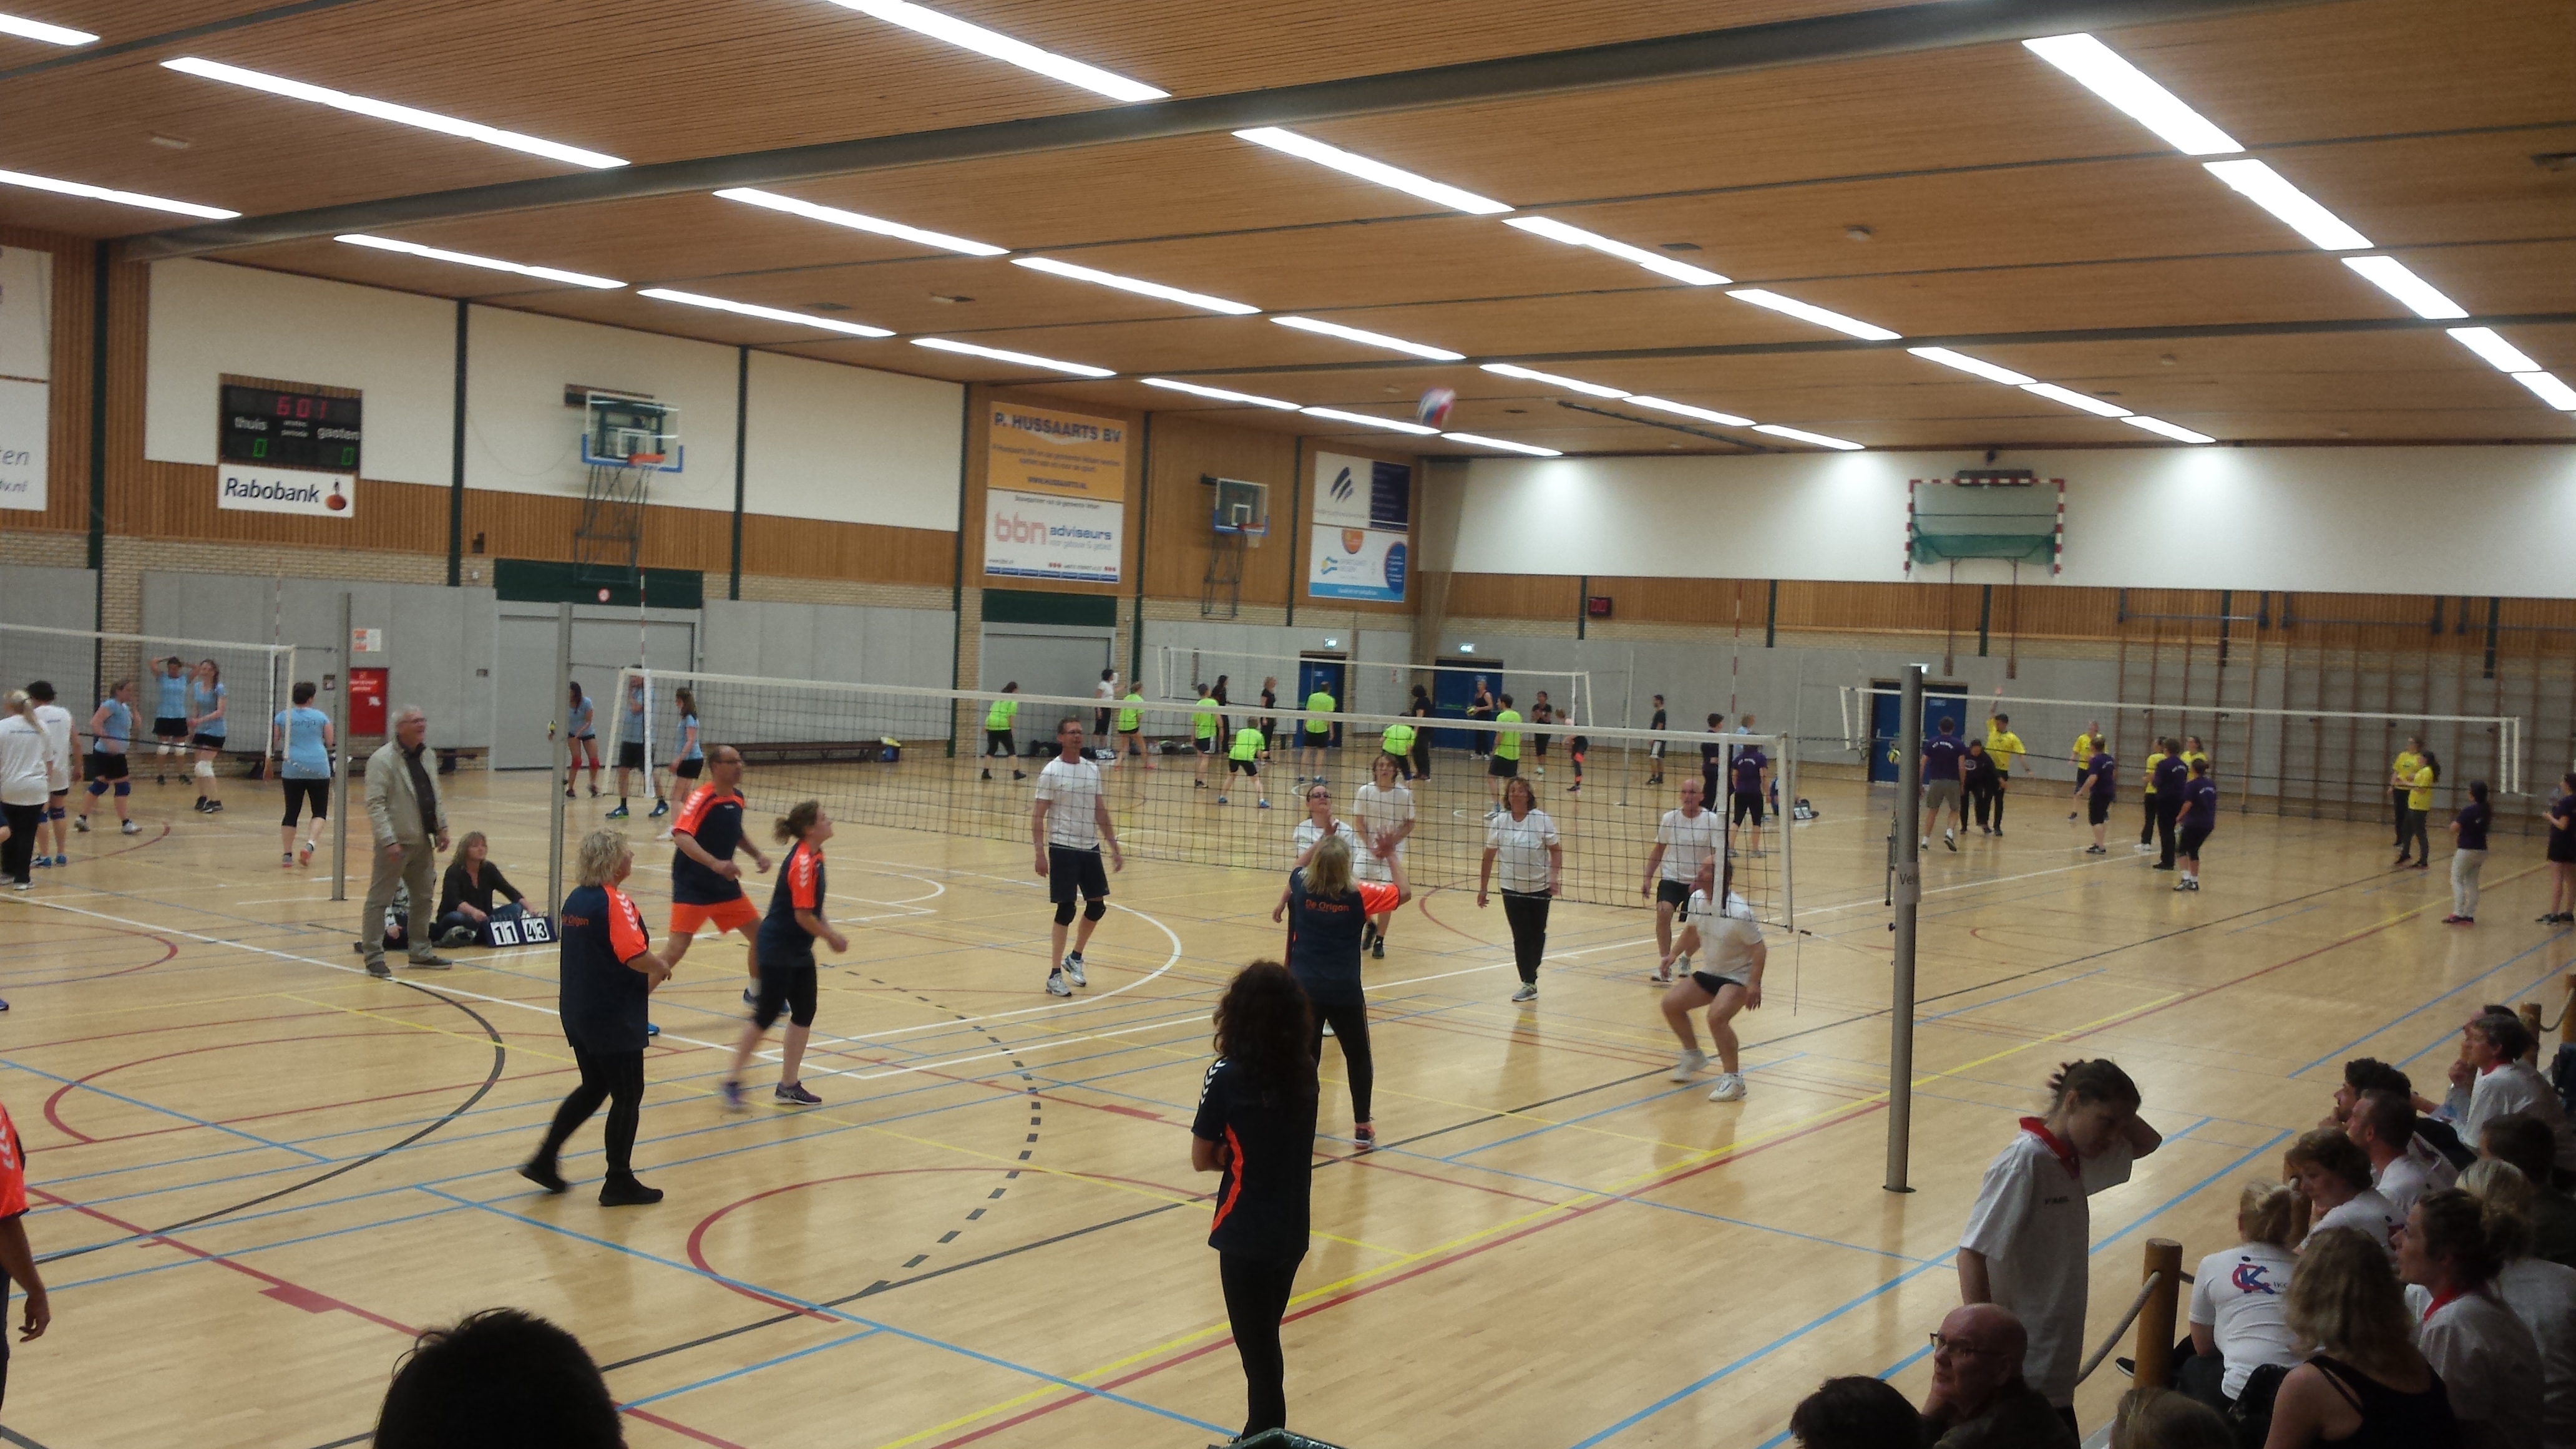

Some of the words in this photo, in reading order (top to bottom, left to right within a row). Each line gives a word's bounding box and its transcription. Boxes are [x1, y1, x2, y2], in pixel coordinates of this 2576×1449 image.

[235, 416, 268, 431] thuis
[317, 427, 361, 441] gasten
[1012, 415, 1098, 441] HUSSAARTS
[1103, 427, 1121, 442] BV
[0, 446, 29, 466] en
[252, 437, 268, 459] 0
[341, 446, 355, 466] 0
[224, 477, 320, 503] Rabobank
[994, 512, 1046, 545] bbn
[1050, 525, 1112, 540] adviseurs
[495, 925, 517, 943] 11
[527, 922, 547, 940] 43
